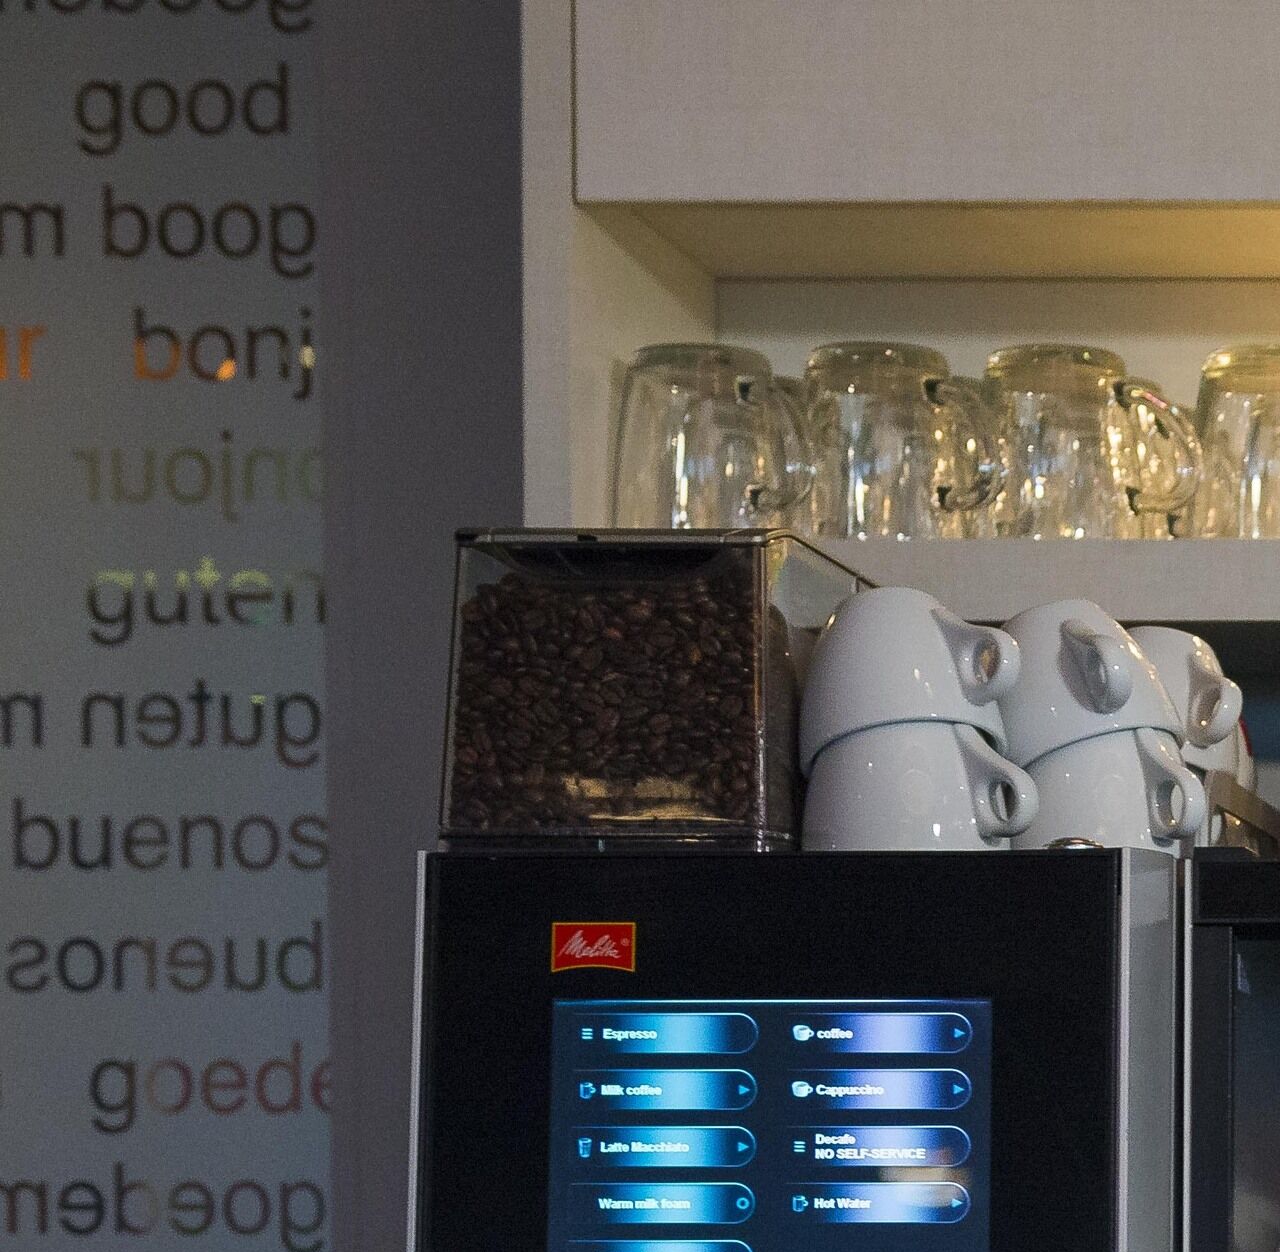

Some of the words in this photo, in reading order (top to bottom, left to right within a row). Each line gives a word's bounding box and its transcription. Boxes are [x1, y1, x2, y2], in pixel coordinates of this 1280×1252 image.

[74, 62, 291, 157] good
[134, 307, 317, 401] bonj
[87, 555, 327, 647] guten
[12, 798, 328, 871] buenos
[557, 929, 622, 959] Melitta
[603, 1029, 657, 1041] Espresso
[817, 1028, 853, 1039] coffee
[626, 1085, 662, 1096] coffee
[816, 1084, 884, 1098] Cappuccino
[600, 1142, 629, 1153] Latte
[631, 1142, 689, 1153] Macchiato
[815, 1148, 834, 1160] NO
[836, 1148, 926, 1160] SELF-SERVICE
[599, 1198, 631, 1210] Warm
[633, 1198, 658, 1210] milk
[660, 1198, 691, 1210] foam
[814, 1198, 834, 1210] Hot
[836, 1198, 871, 1210] Water
